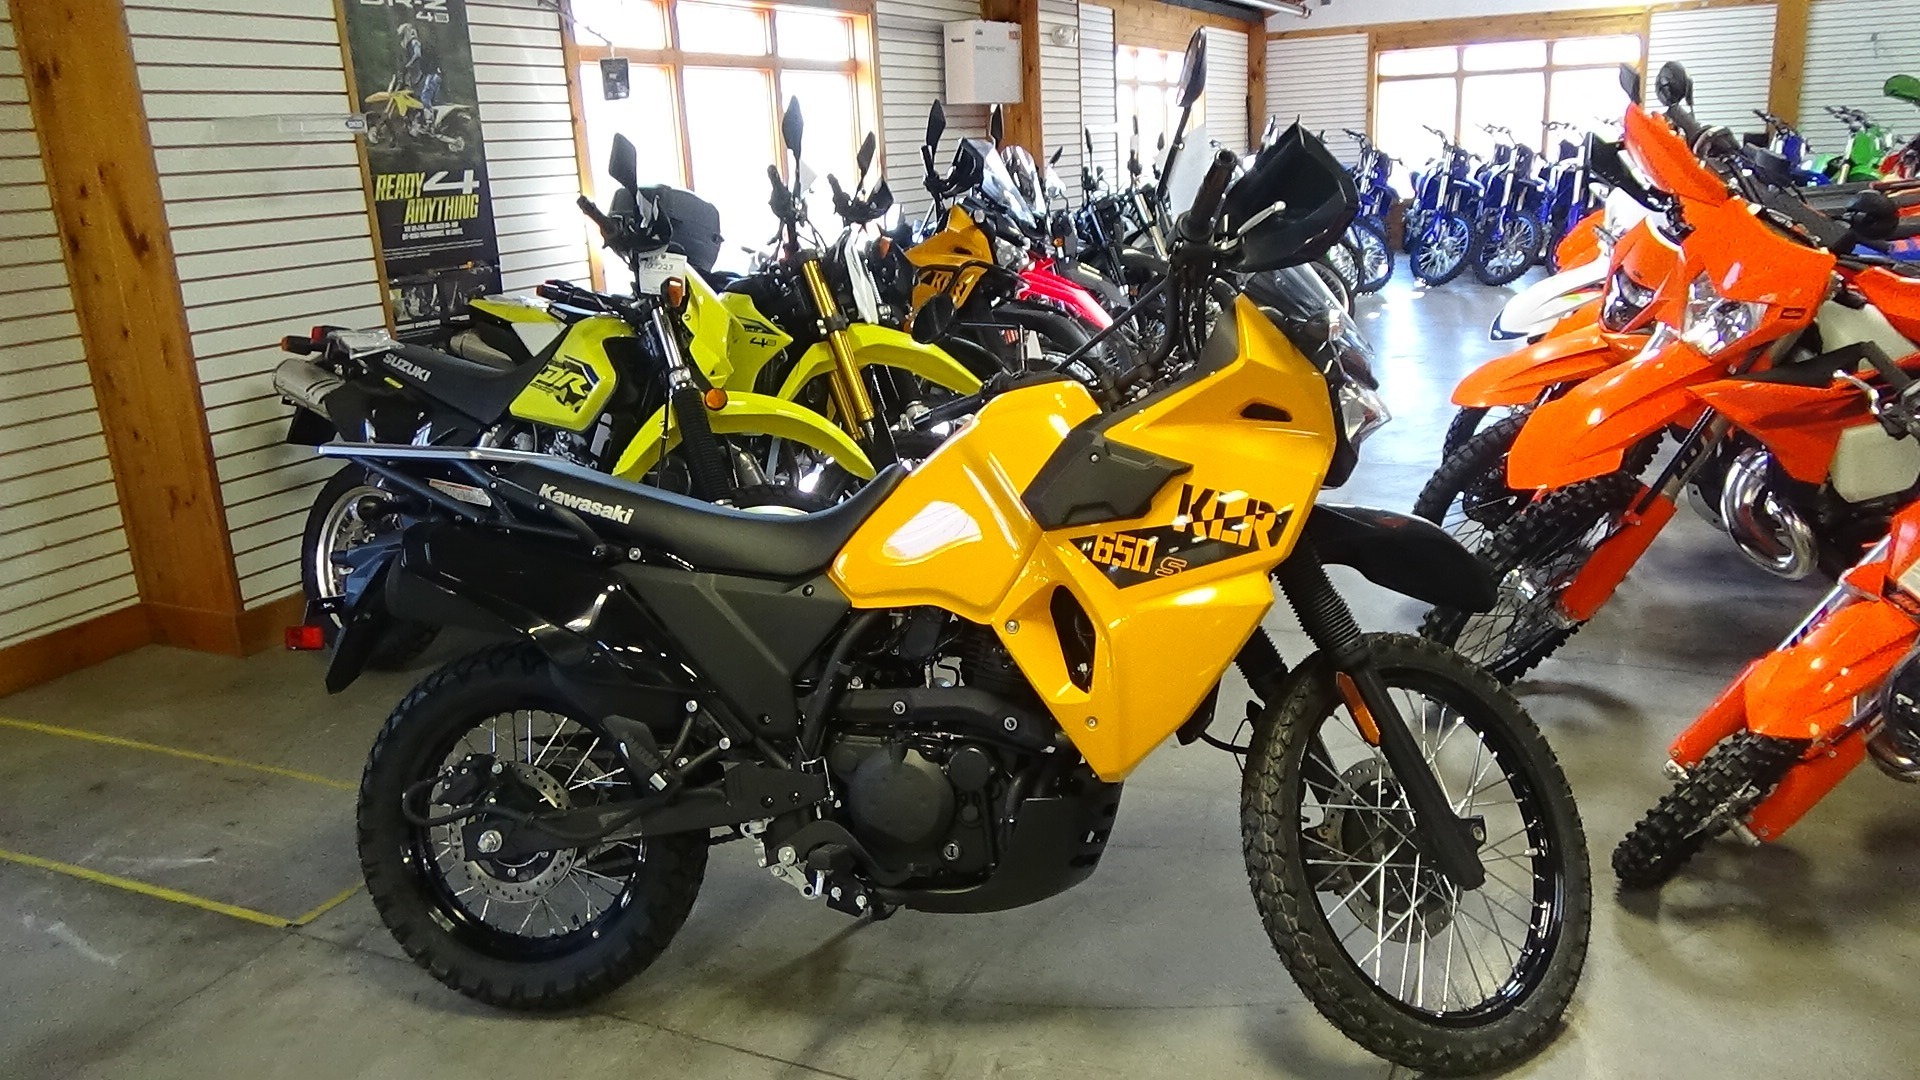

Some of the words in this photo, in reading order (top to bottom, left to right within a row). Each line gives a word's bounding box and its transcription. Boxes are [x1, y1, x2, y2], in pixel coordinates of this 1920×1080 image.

[375, 172, 425, 200] READY
[423, 169, 480, 194] 4
[404, 194, 479, 224] ANYTHING
[383, 353, 431, 382] SUZUKI
[539, 483, 634, 524] Kawasaki
[1173, 483, 1276, 549] KLR
[1091, 534, 1157, 573] 650
[1155, 557, 1187, 577] S
